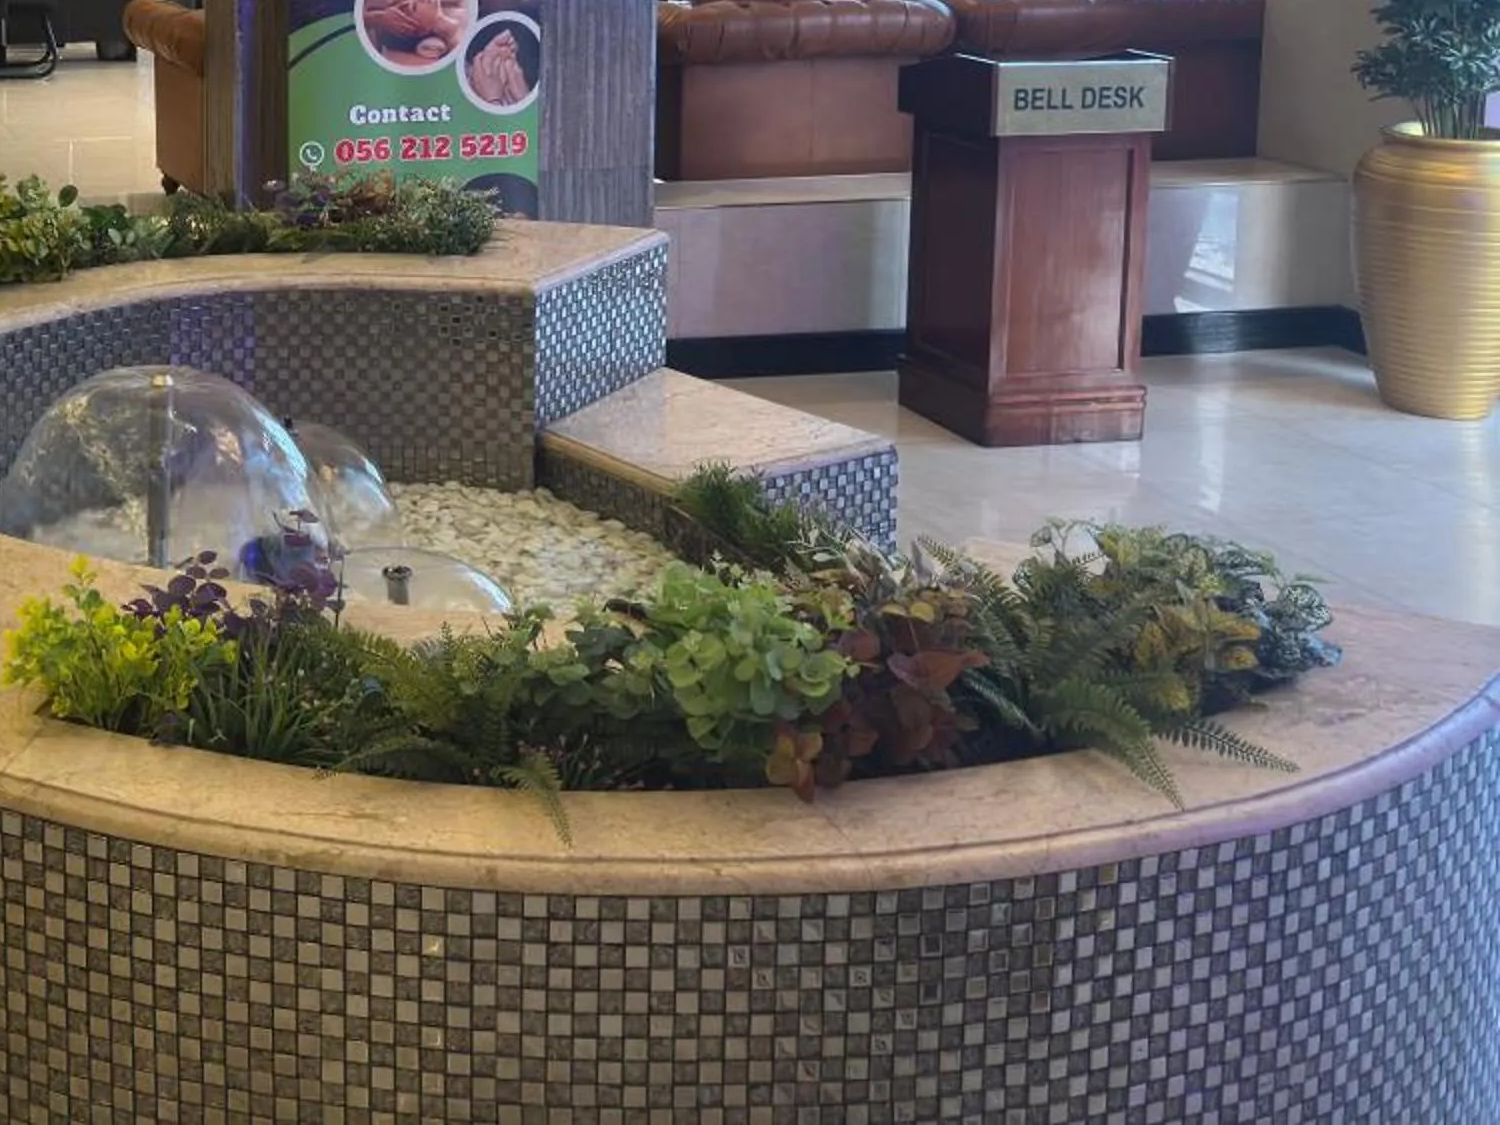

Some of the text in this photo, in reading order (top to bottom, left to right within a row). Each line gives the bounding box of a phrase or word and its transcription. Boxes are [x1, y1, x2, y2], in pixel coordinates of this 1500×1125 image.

[1013, 86, 1146, 111] BELL DESK
[349, 104, 452, 125] Contact
[334, 129, 531, 165] 056 212 5219
